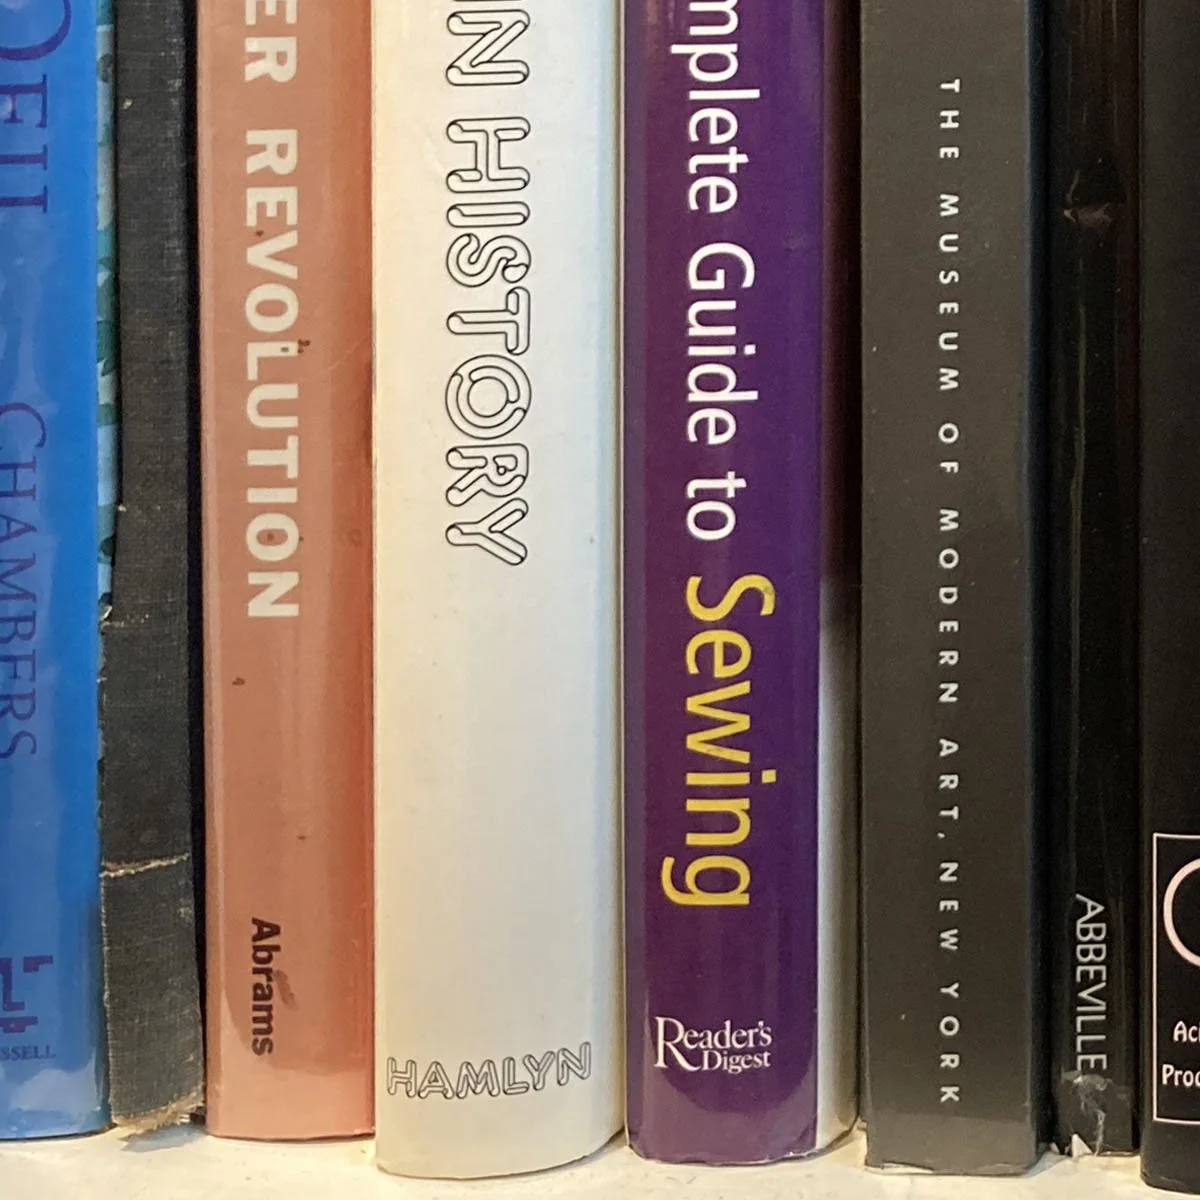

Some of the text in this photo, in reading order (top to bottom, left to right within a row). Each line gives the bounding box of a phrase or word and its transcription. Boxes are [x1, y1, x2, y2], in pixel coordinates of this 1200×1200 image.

[941, 80, 961, 159] THE
[446, 118, 533, 567] HISTORY
[689, 244, 759, 445] Guide
[940, 195, 960, 391] MUSEUM
[245, 131, 301, 618] REVOLUTION
[688, 473, 747, 541] to
[940, 424, 959, 473] OF
[940, 510, 959, 703] MODERN
[663, 576, 777, 906] Sewing
[941, 864, 959, 951] NEW
[250, 918, 283, 1057] Abrams
[941, 984, 960, 1103] YORK
[1076, 893, 1108, 1071] ABBEVILLE
[388, 1043, 592, 1100] HAMLYN
[700, 1044, 772, 1075] Digest
